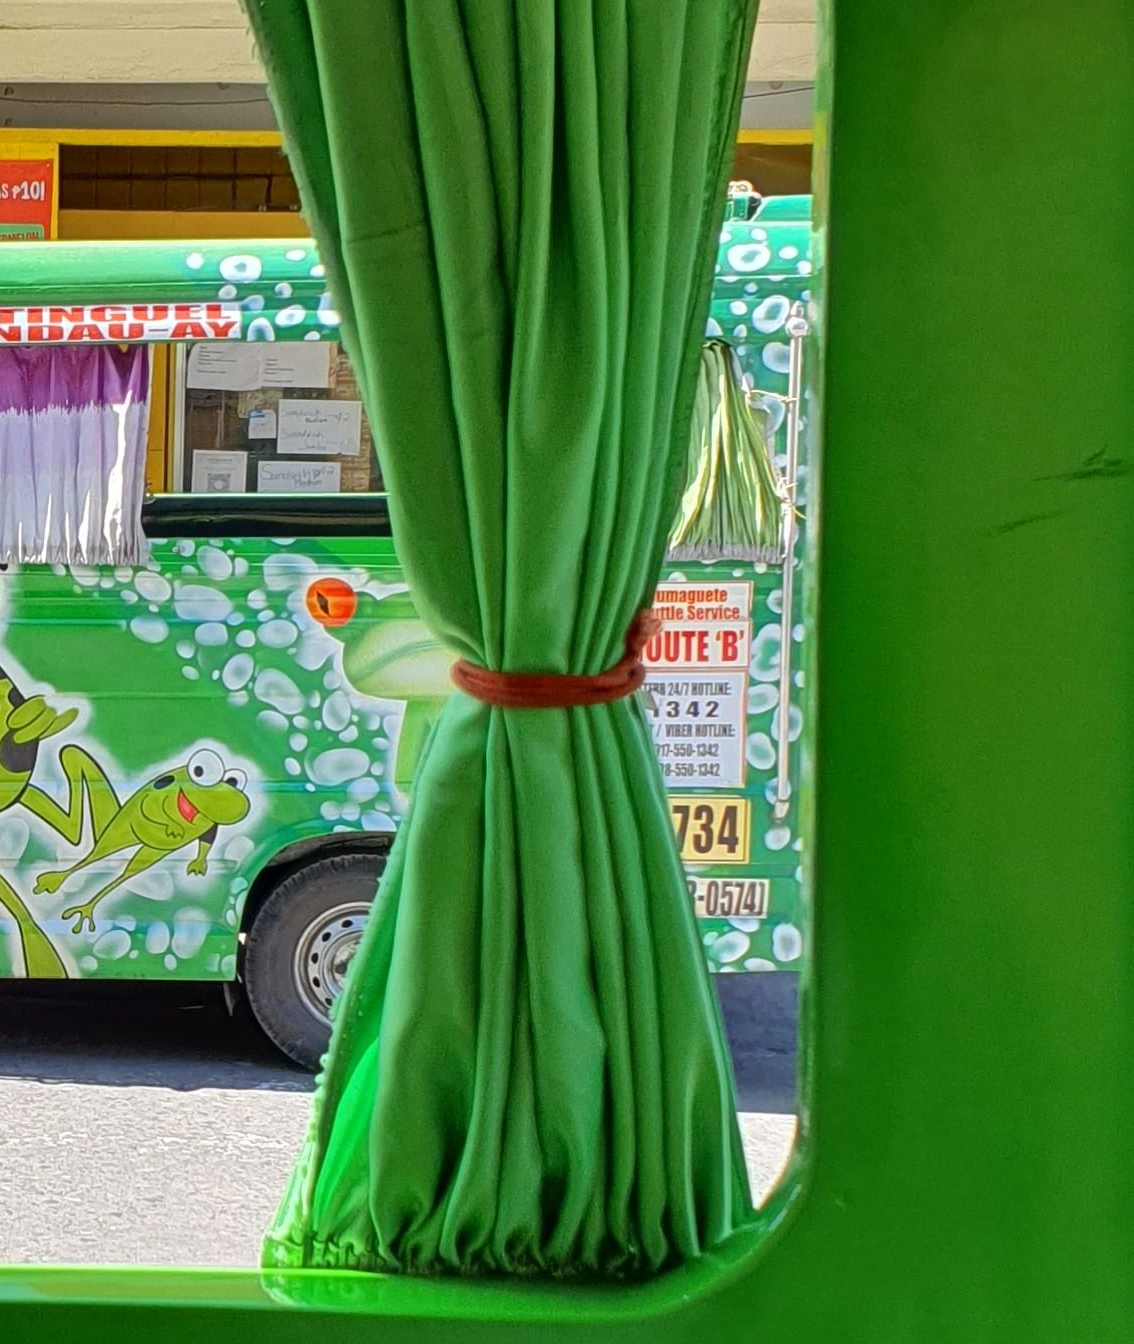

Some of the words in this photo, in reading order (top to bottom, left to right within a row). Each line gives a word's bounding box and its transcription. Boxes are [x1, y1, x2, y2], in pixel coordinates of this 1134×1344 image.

[654, 588, 728, 604] umaguete
[687, 605, 740, 621] Service
[646, 630, 709, 662] OUTE
[668, 682, 690, 696] 24/7
[665, 724, 693, 737] VIBER
[656, 743, 720, 757] 17-550-1342
